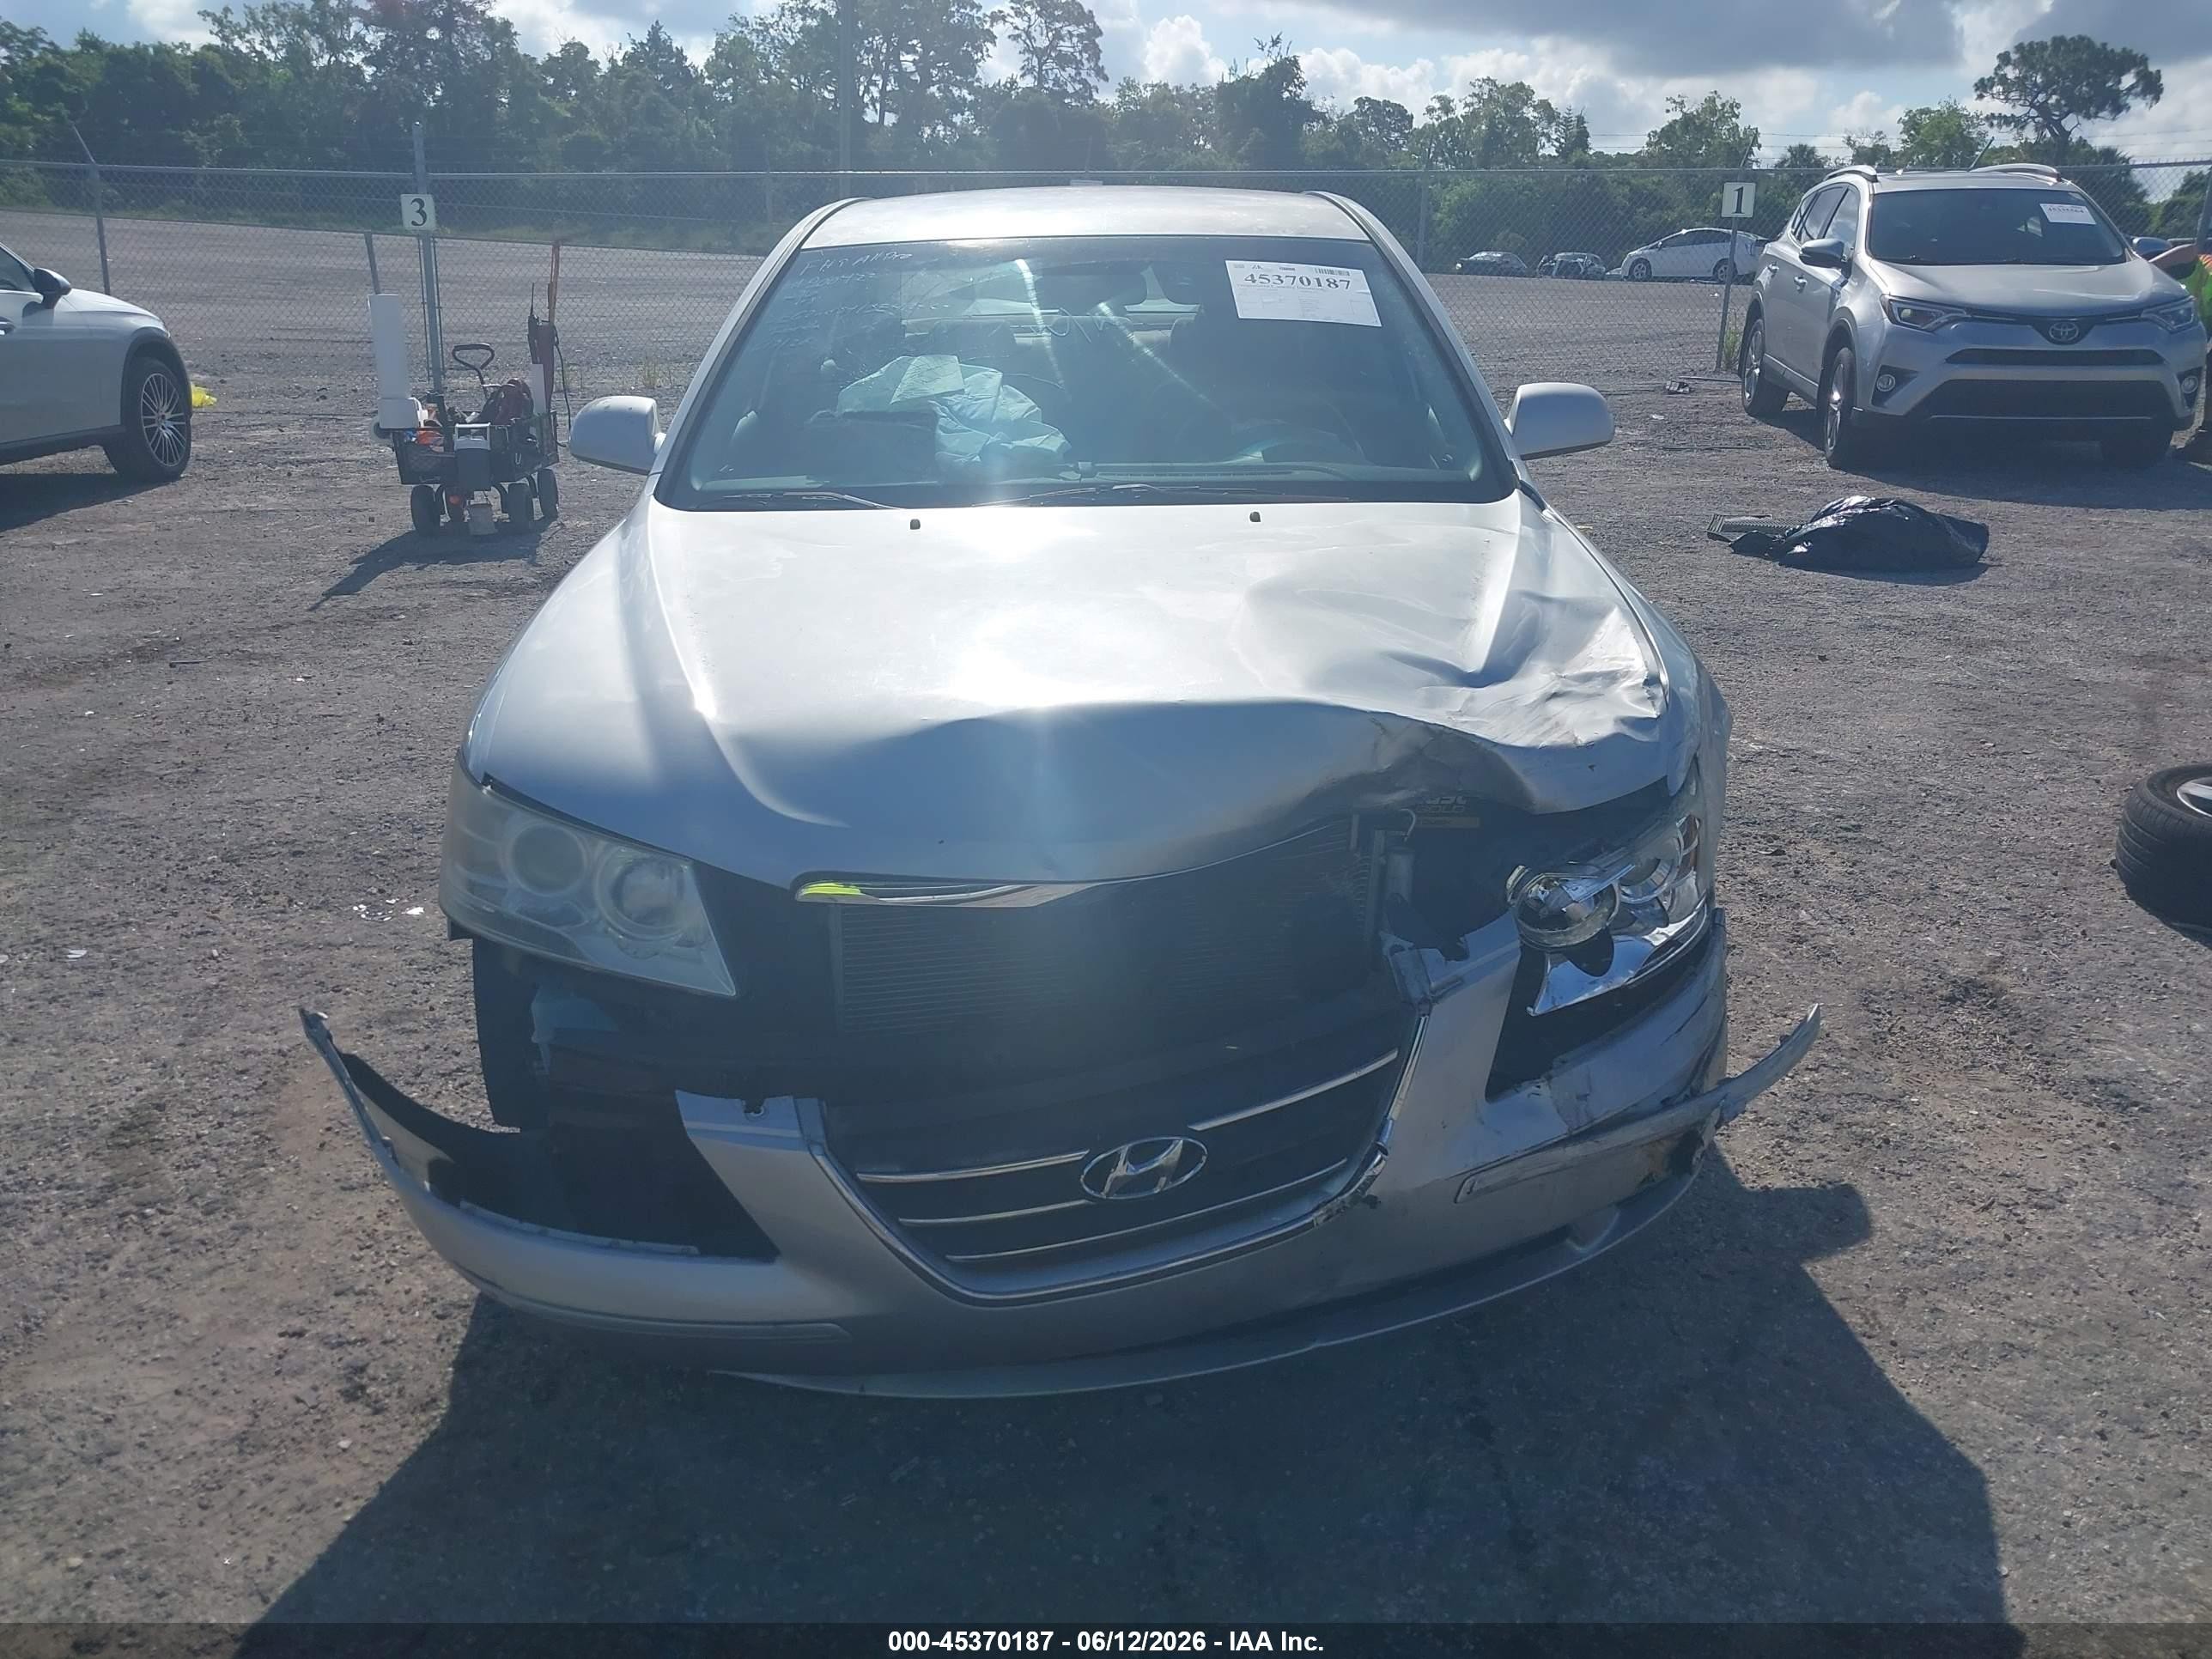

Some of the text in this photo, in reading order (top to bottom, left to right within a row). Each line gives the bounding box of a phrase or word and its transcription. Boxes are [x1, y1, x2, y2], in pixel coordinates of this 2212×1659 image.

[411, 198, 427, 227] 3
[1731, 185, 1745, 214] 1
[1244, 272, 1351, 290] 45370187
